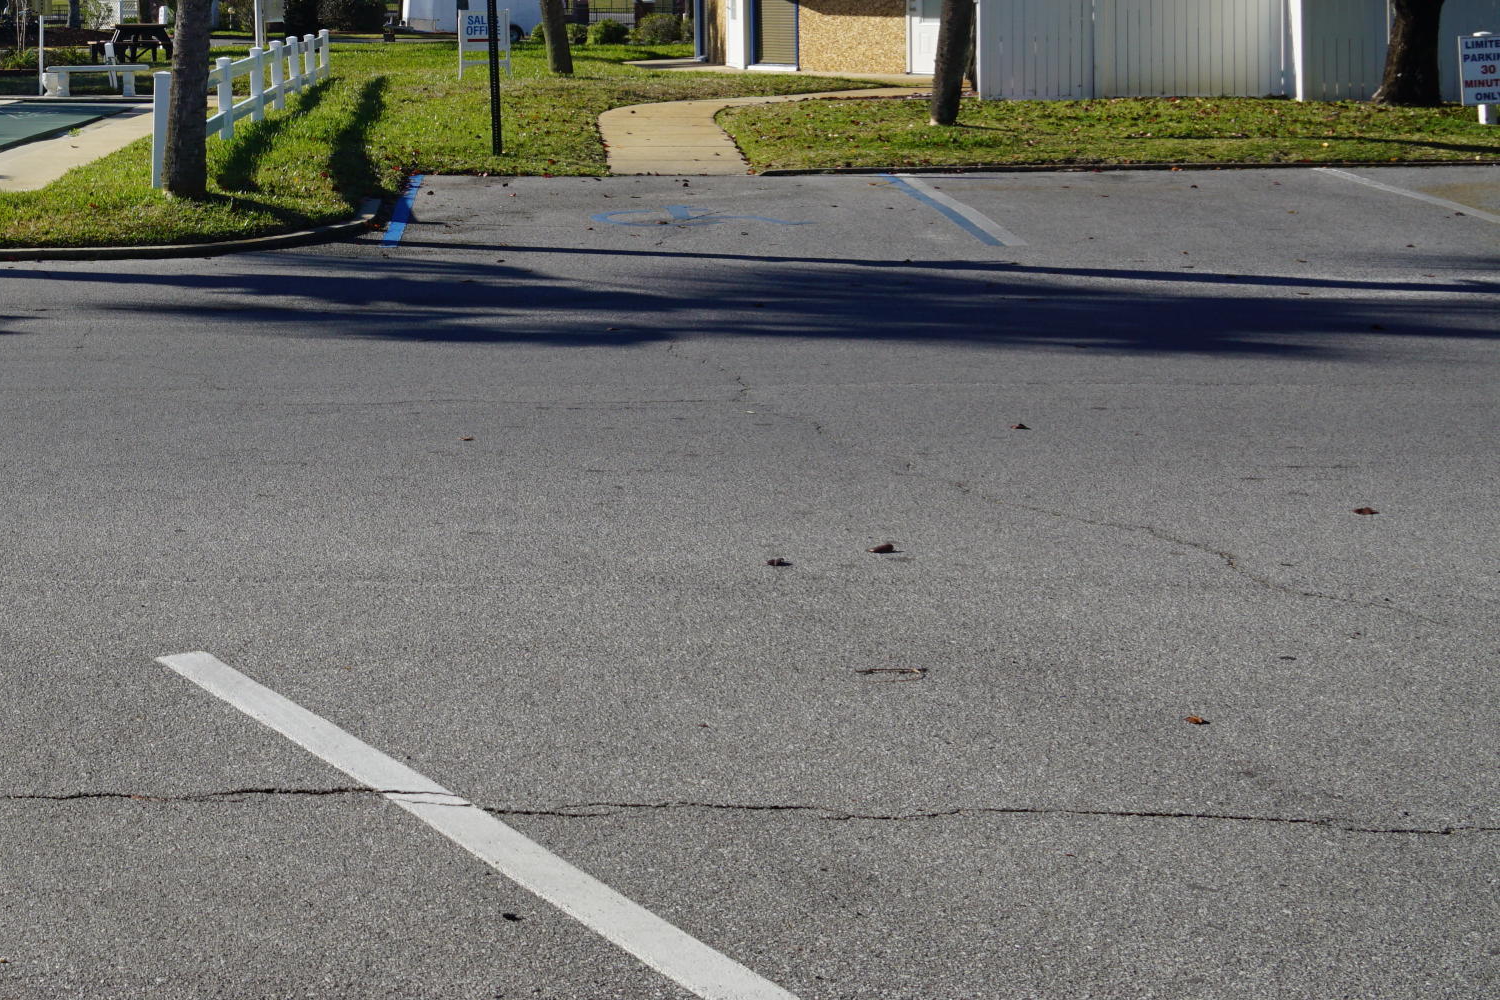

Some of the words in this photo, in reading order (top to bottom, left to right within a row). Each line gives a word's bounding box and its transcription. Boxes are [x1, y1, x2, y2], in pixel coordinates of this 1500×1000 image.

[467, 15, 499, 25] SAL
[466, 25, 501, 36] OFFIE
[1465, 40, 1500, 49] LIMITE
[1481, 65, 1496, 75] 30
[1464, 79, 1500, 88] MINUT
